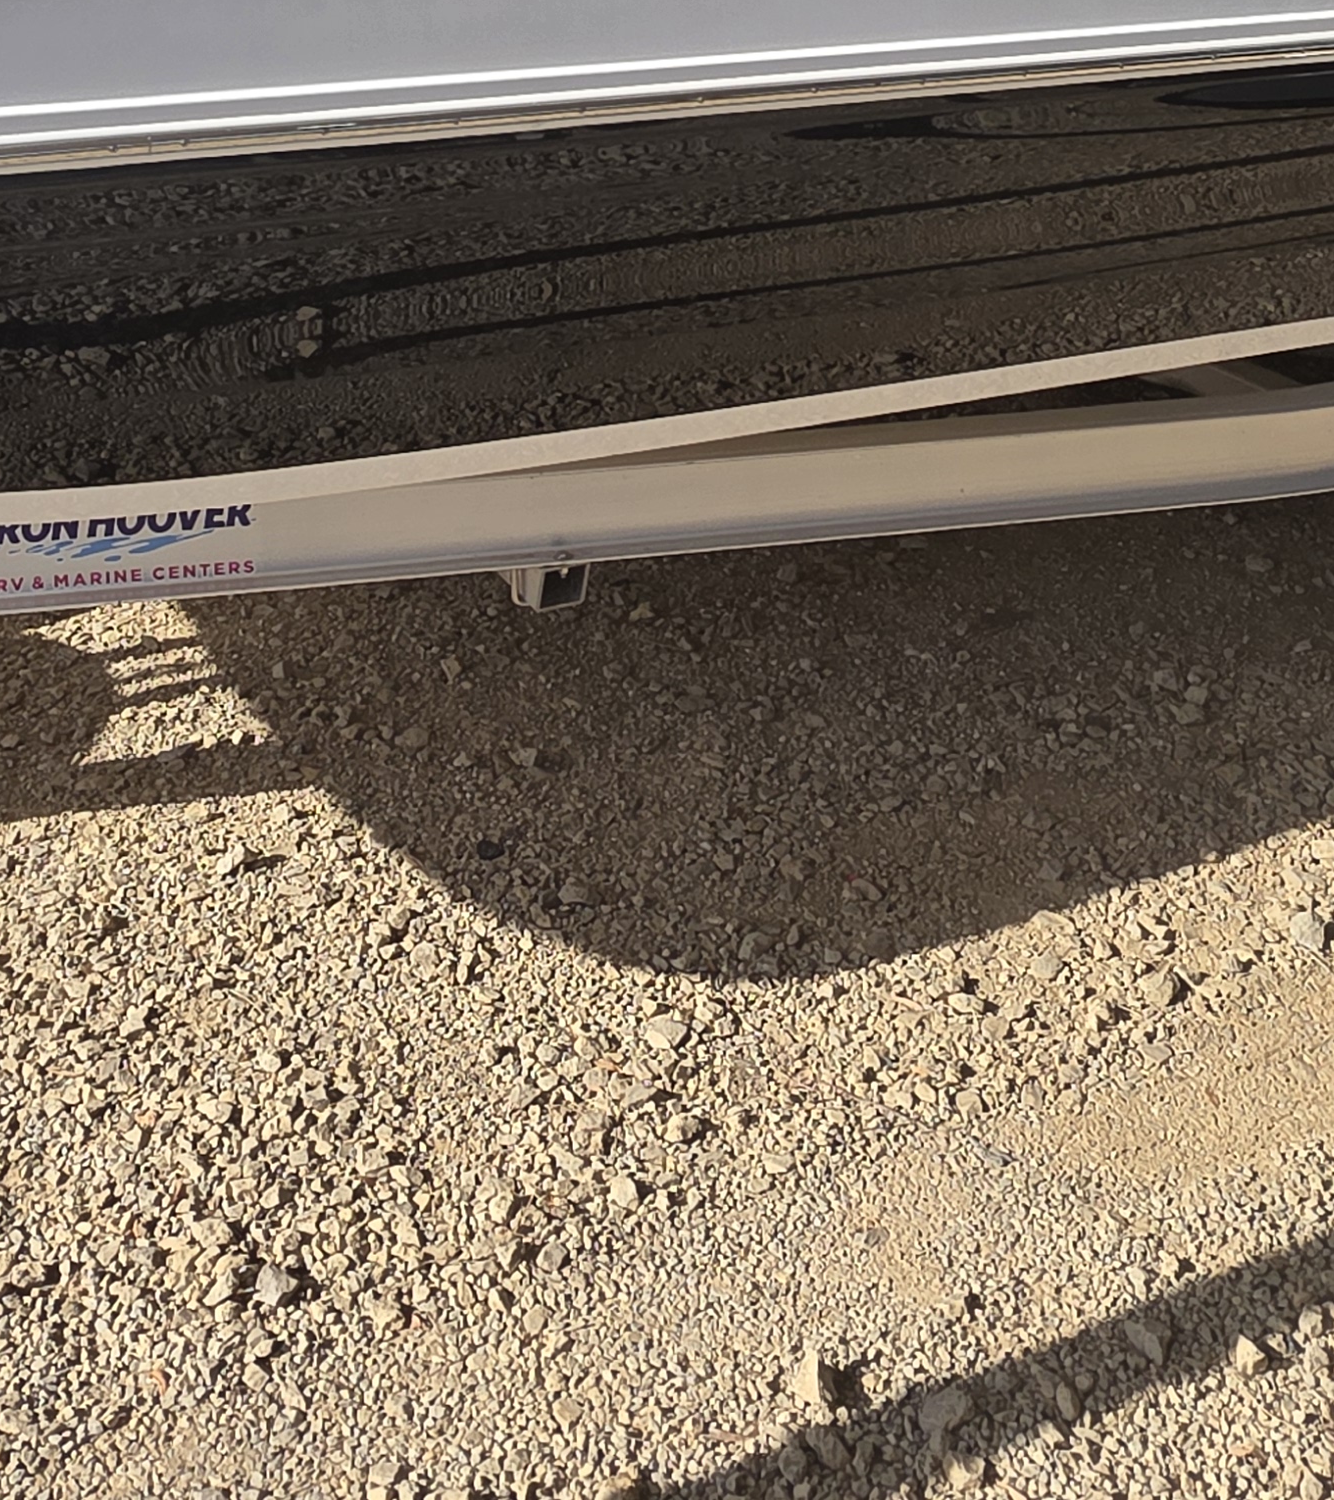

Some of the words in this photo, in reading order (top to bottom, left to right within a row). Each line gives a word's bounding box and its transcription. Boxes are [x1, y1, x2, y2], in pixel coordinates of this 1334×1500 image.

[32, 576, 45, 590] &
[54, 568, 142, 588] MARINE
[153, 560, 255, 581] CENTERS
